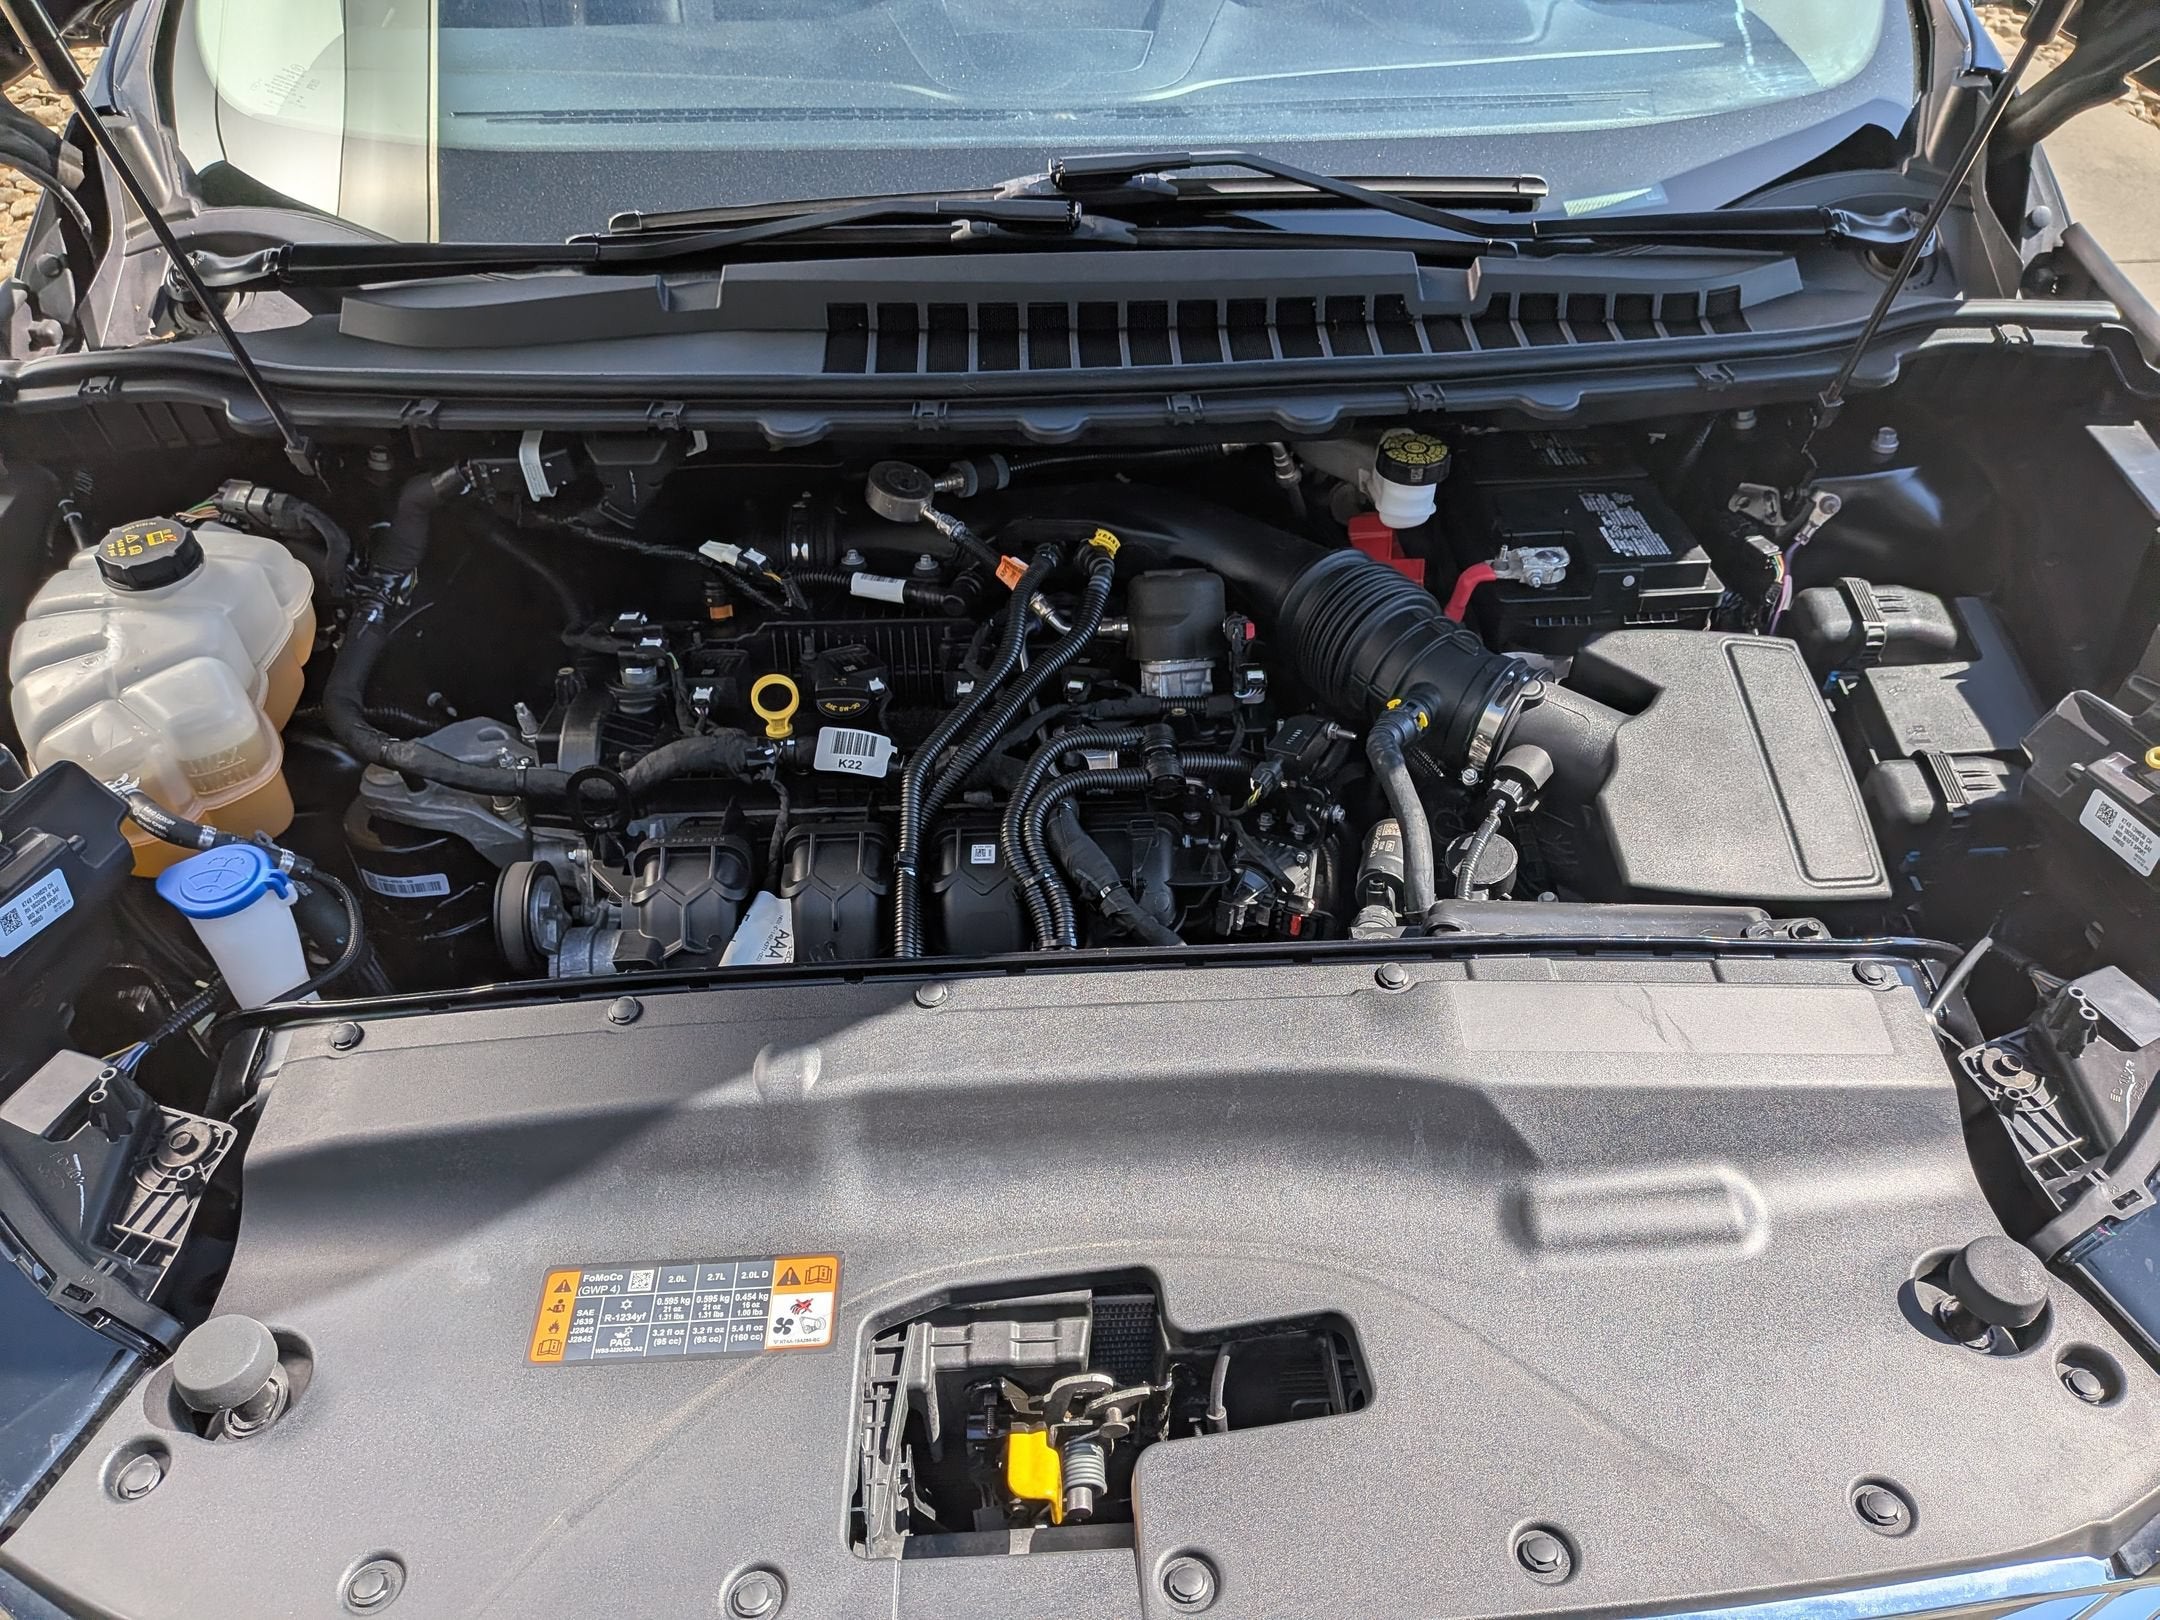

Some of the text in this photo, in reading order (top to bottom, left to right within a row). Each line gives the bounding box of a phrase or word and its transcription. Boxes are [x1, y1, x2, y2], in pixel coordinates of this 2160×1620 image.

[838, 759, 862, 770] K22
[765, 929, 790, 958] AAA
[582, 1273, 623, 1282] FoMoCo
[668, 1275, 687, 1283] 2.0L
[707, 1273, 726, 1281] 2.7L
[741, 1270, 769, 1280] 2.0L D
[577, 1284, 620, 1296] (GWP 4)
[656, 1296, 691, 1306] 0.595 kg
[695, 1294, 730, 1304] 0.595 kg
[735, 1292, 769, 1302] 0.454 kg
[576, 1309, 595, 1317] SAE
[604, 1312, 647, 1322] R-1234yf
[658, 1313, 673, 1321] 1.31
[697, 1311, 712, 1319] 1.31
[569, 1327, 594, 1335] J2842
[652, 1329, 665, 1337] 3.2
[692, 1327, 705, 1335] 3.2
[568, 1335, 592, 1343] J2845
[653, 1337, 682, 1347] (95 cc)
[708, 1336, 722, 1344] cc)
[730, 1333, 763, 1343] (160 cc)
[609, 1339, 631, 1347] PAG
